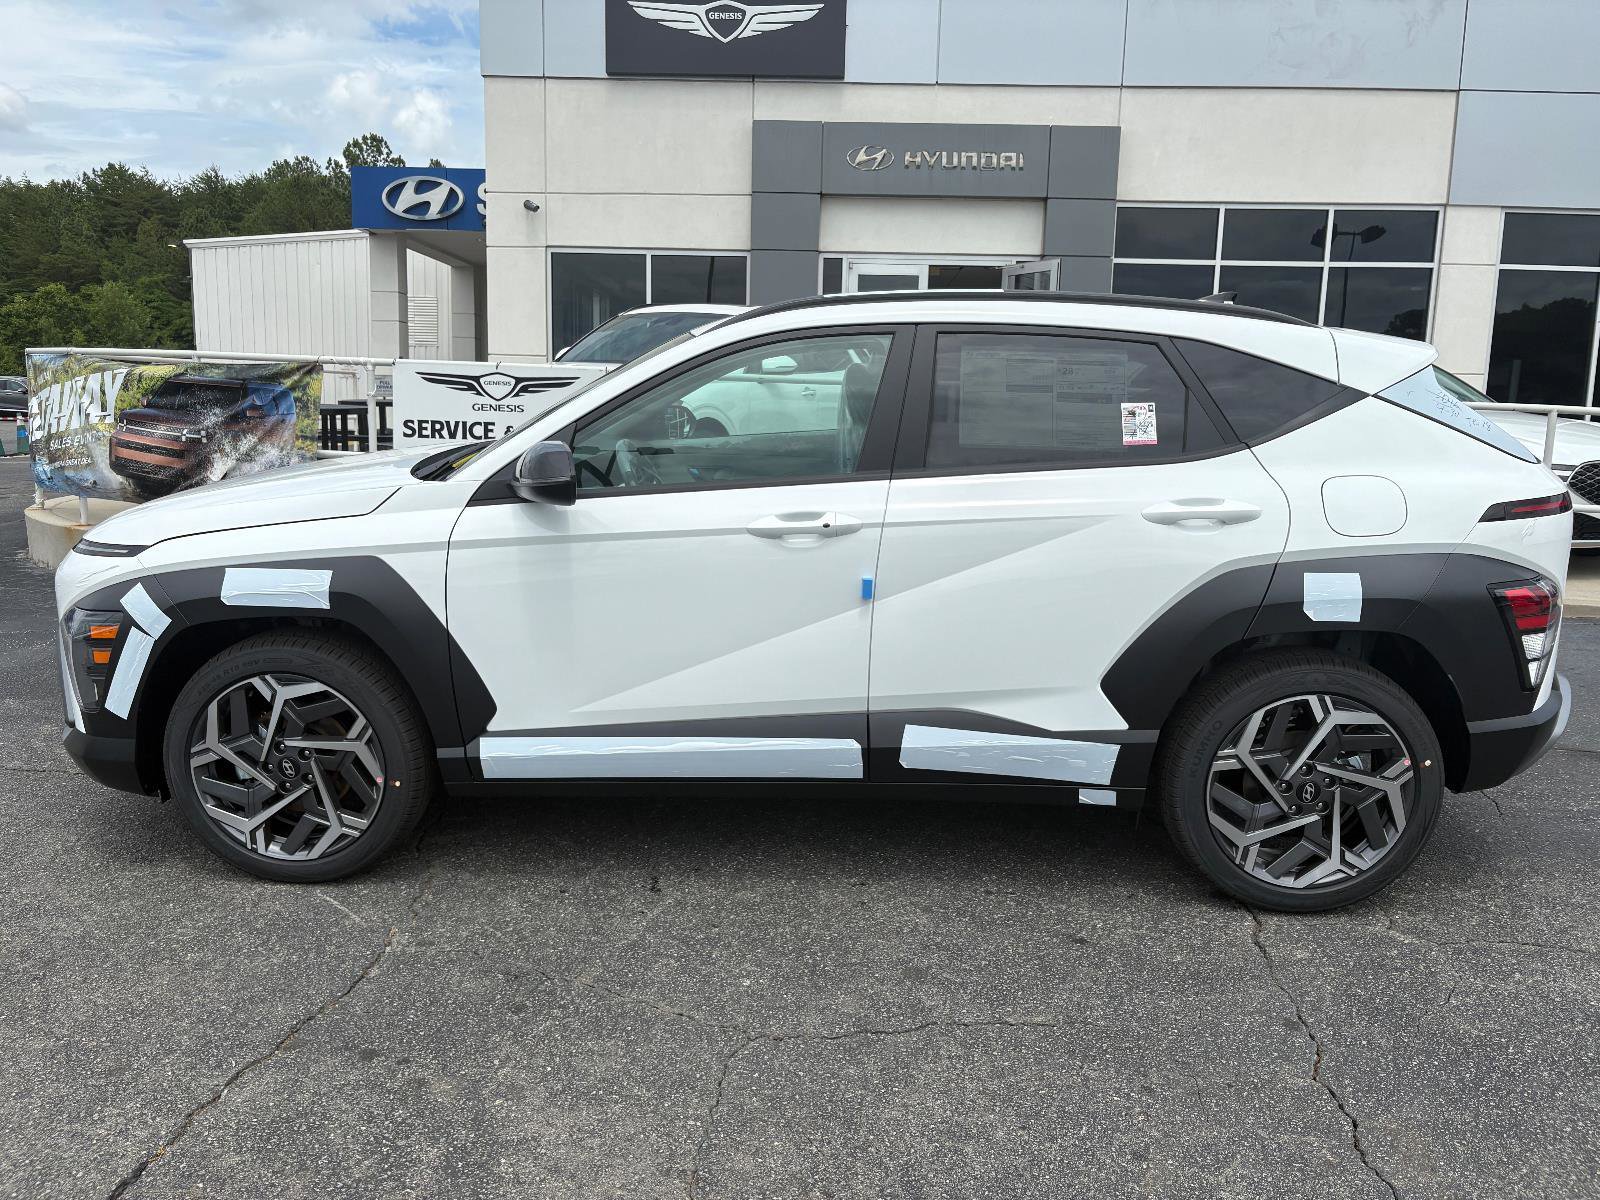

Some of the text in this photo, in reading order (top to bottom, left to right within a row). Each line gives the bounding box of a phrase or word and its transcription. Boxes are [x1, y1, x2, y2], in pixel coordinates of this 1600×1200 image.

[708, 11, 743, 20] GENESIS
[903, 151, 1024, 171] HYUNDAI
[483, 379, 512, 387] GENESIS
[472, 403, 525, 413] GENESIS
[402, 419, 496, 440] SERVICE
[49, 436, 71, 450] SALES
